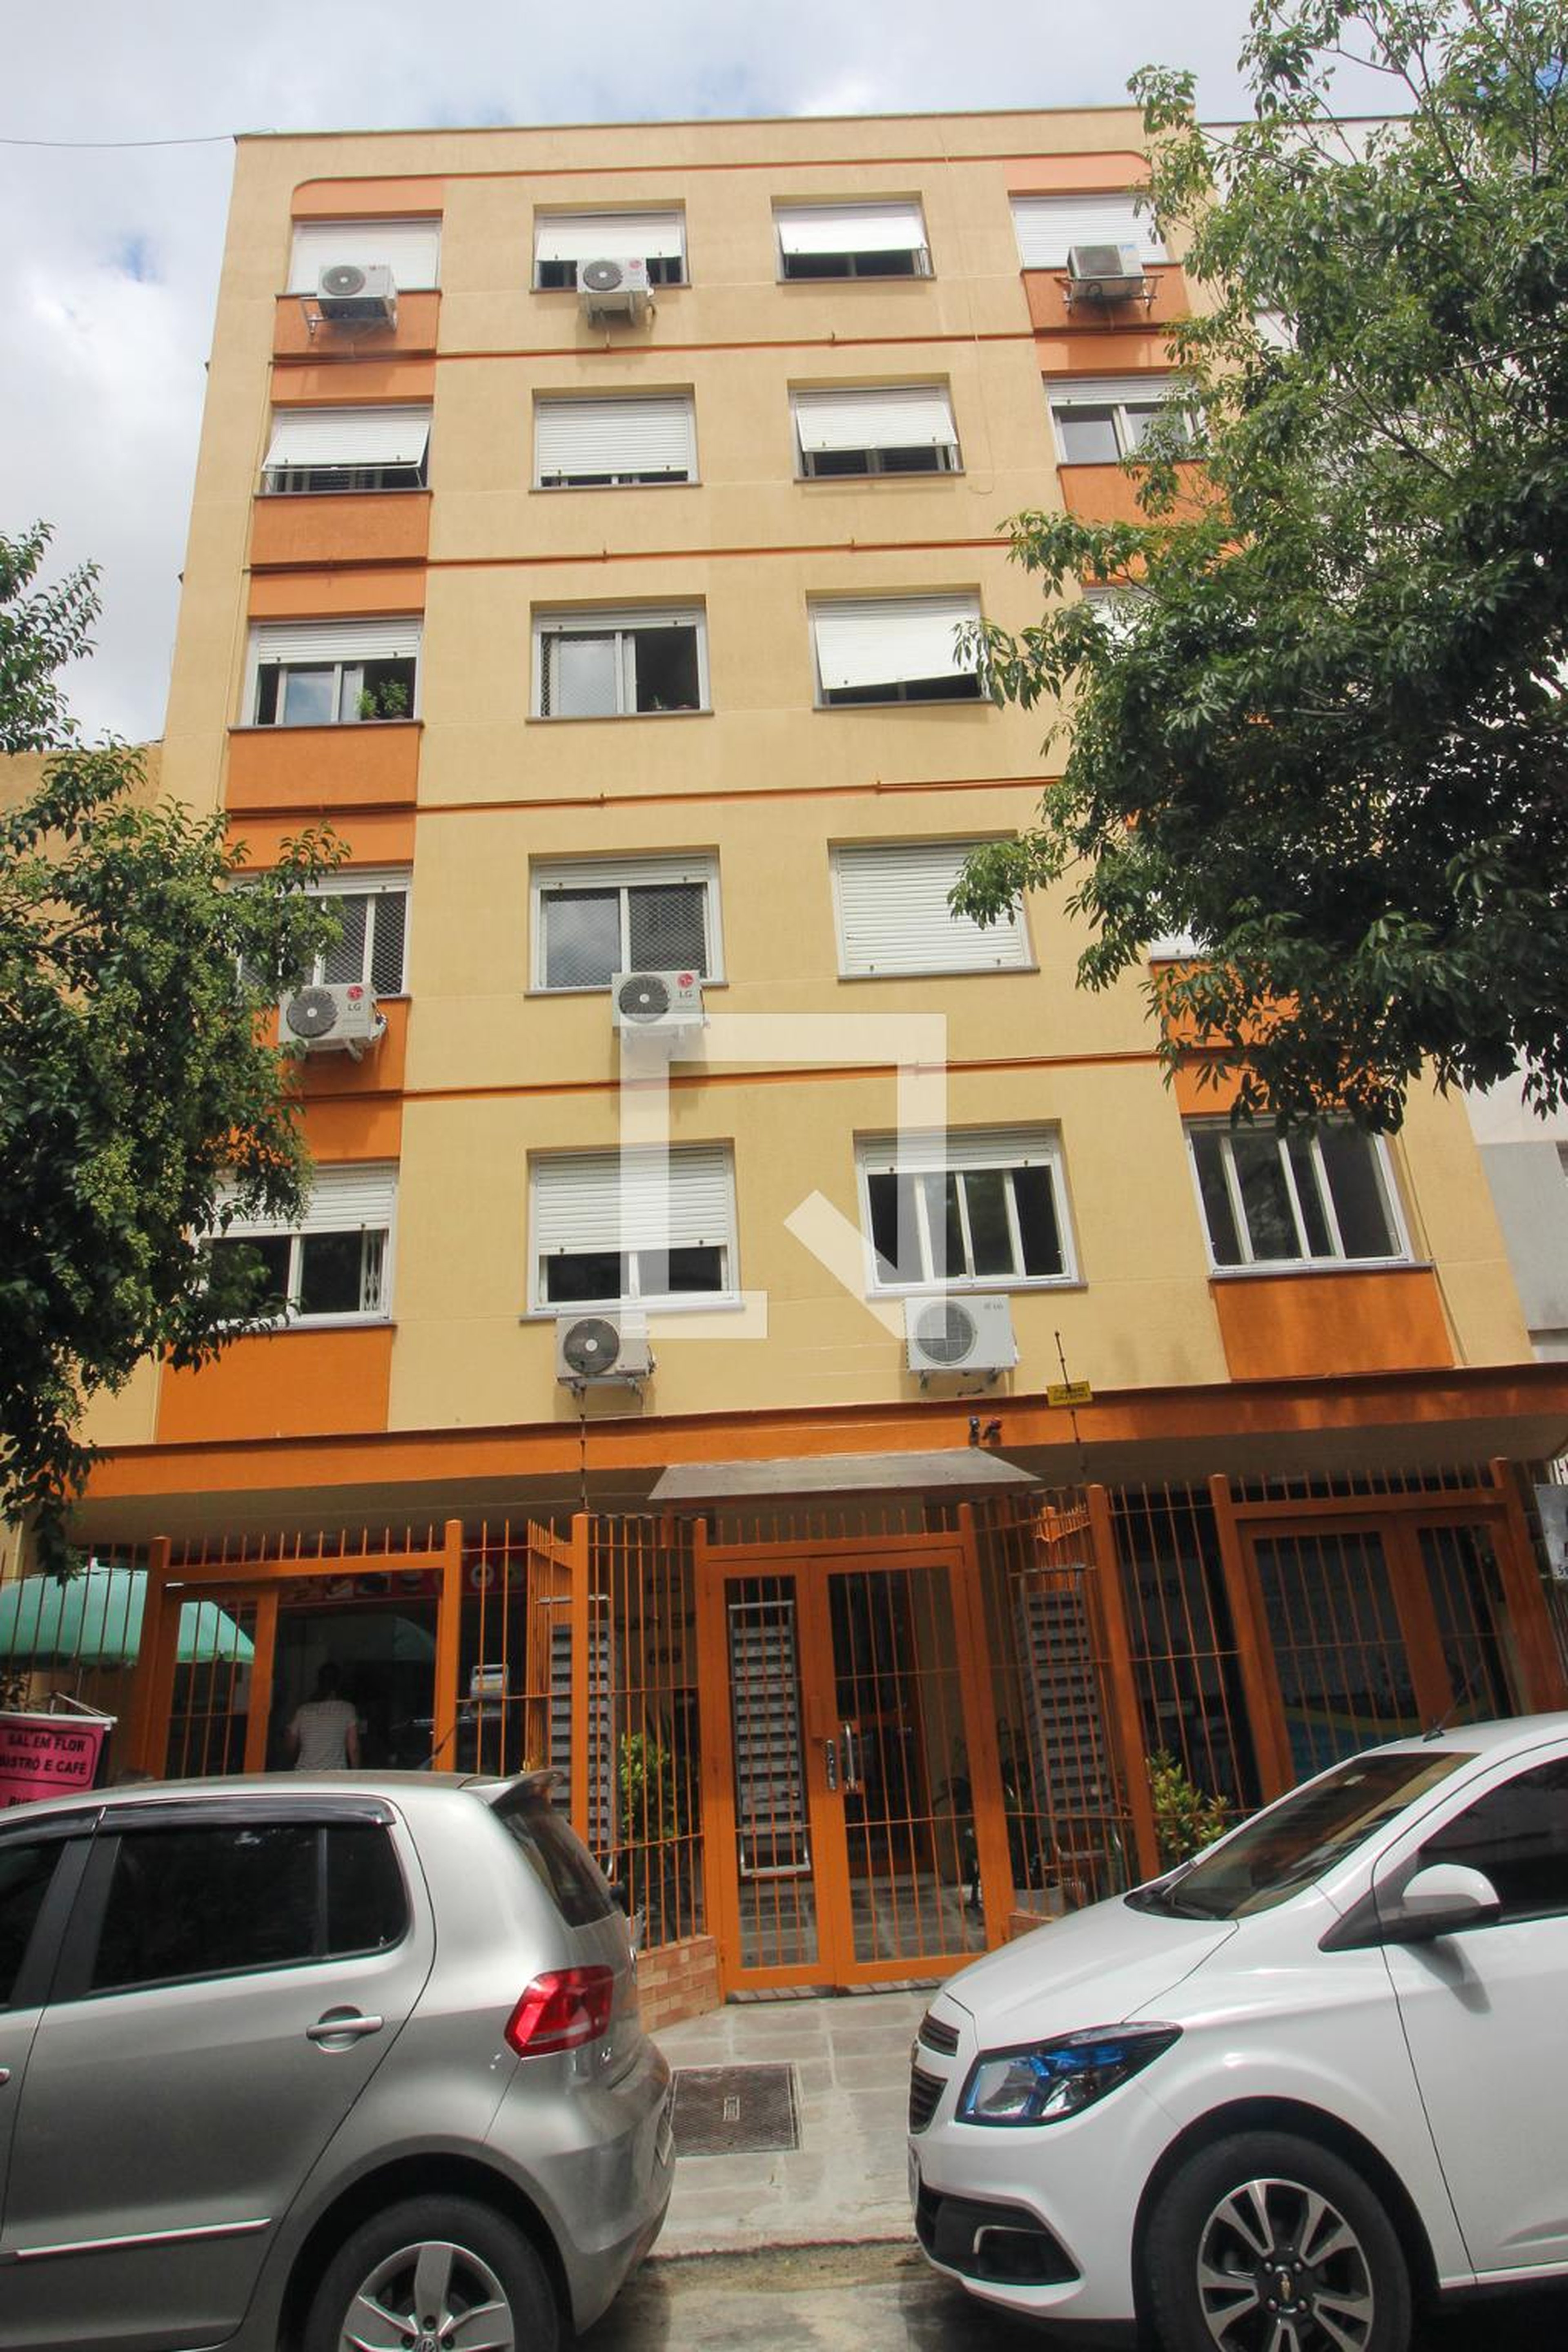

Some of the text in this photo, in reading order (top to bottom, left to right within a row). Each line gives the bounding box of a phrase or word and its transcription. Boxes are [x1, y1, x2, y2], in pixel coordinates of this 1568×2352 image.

[679, 990, 693, 998] LG
[348, 1002, 361, 1011] LG
[33, 1735, 51, 1749] EM
[54, 1737, 86, 1752] FLOR
[44, 1759, 53, 1772] E
